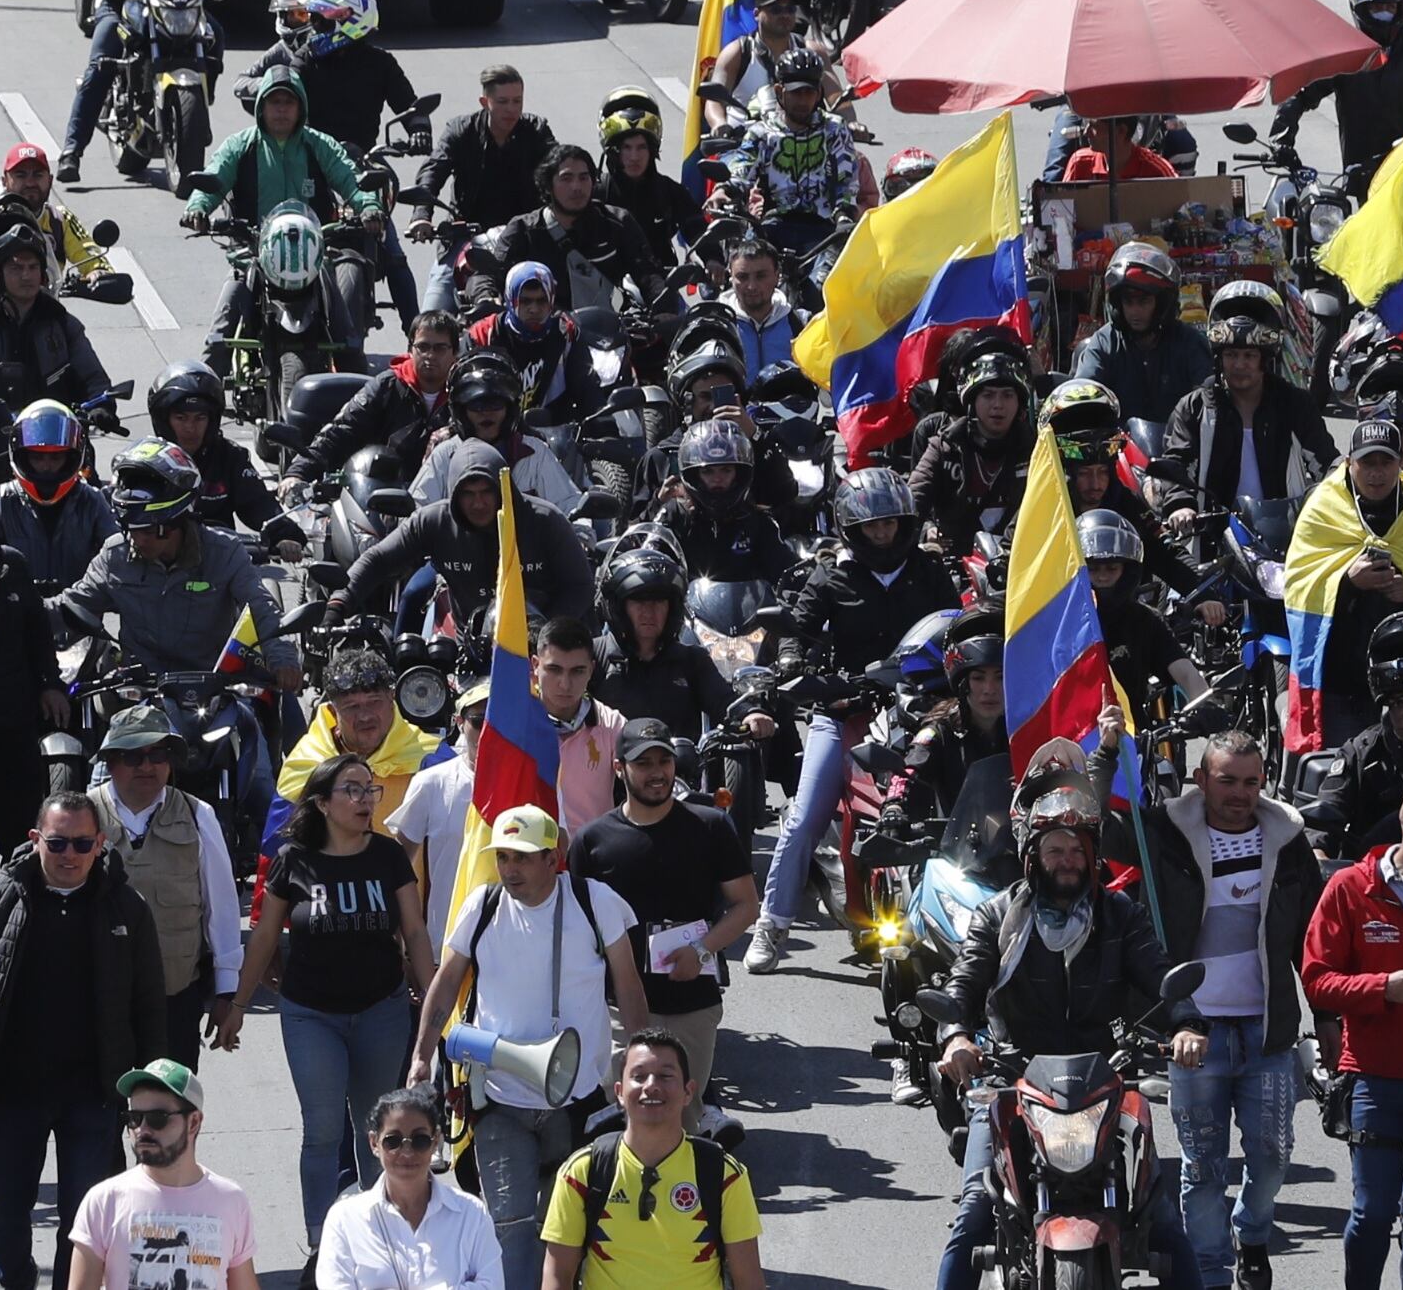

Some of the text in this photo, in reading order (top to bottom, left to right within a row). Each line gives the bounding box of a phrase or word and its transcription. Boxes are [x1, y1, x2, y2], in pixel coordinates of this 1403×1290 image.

[1361, 425, 1390, 438] TOMMY
[444, 561, 472, 572] NEW
[310, 879, 387, 917] RUN
[309, 911, 390, 935] FASTER
[1053, 1075, 1083, 1083] HONDA
